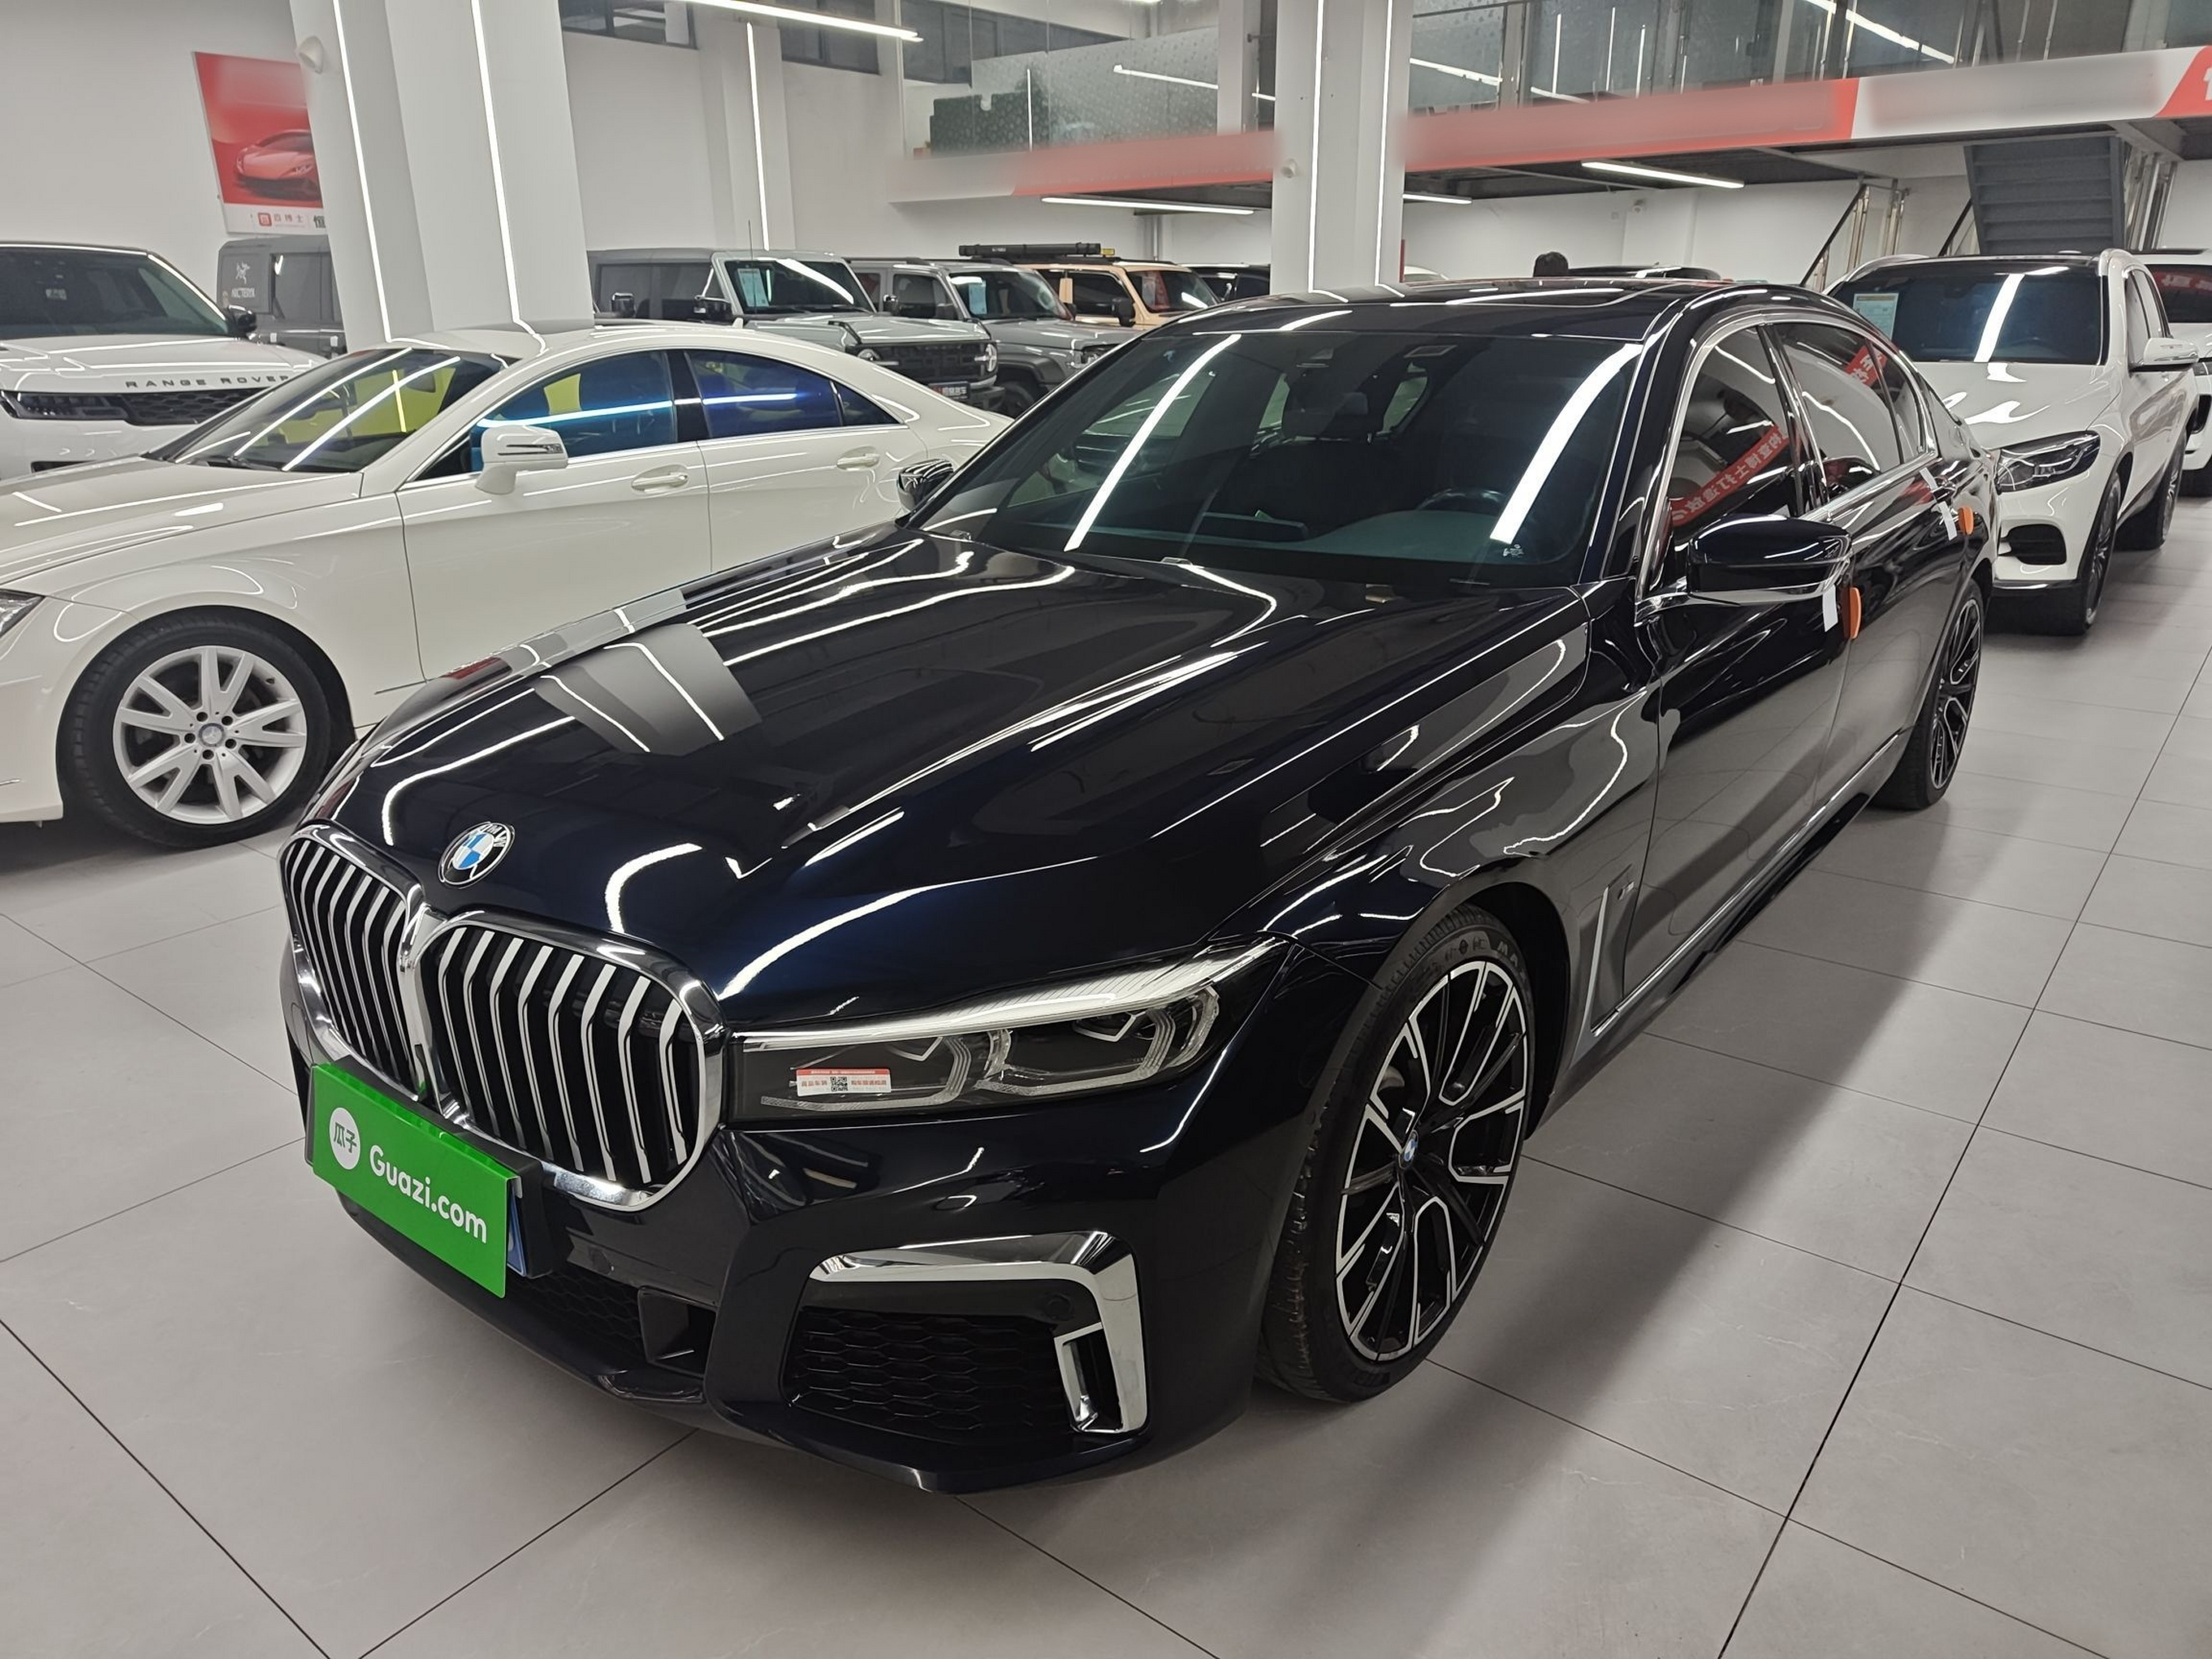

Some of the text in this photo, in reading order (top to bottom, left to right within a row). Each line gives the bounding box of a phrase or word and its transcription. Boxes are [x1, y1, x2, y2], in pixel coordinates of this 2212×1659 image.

[126, 380, 207, 388] RANGE
[333, 1122, 357, 1153] 瓜子
[370, 1145, 487, 1244] Guazi.com
